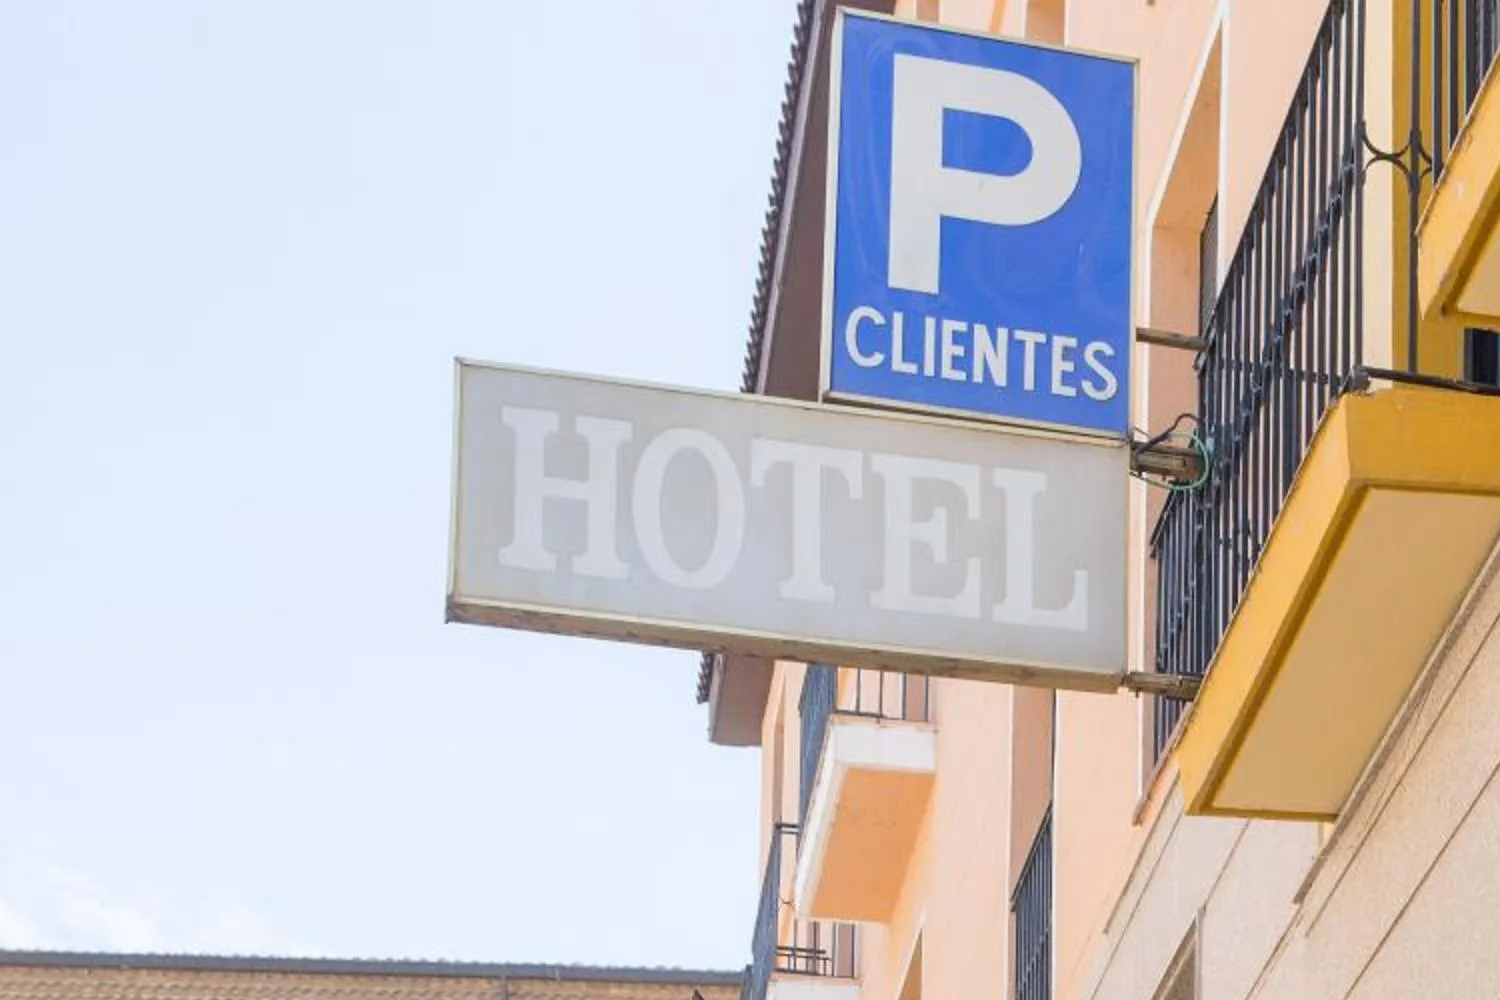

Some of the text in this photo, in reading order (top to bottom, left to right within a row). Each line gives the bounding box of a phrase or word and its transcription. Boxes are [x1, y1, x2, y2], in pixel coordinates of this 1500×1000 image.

[887, 52, 1083, 295] P
[844, 305, 1118, 401] CLIENTES
[499, 404, 1090, 632] HOTEL
